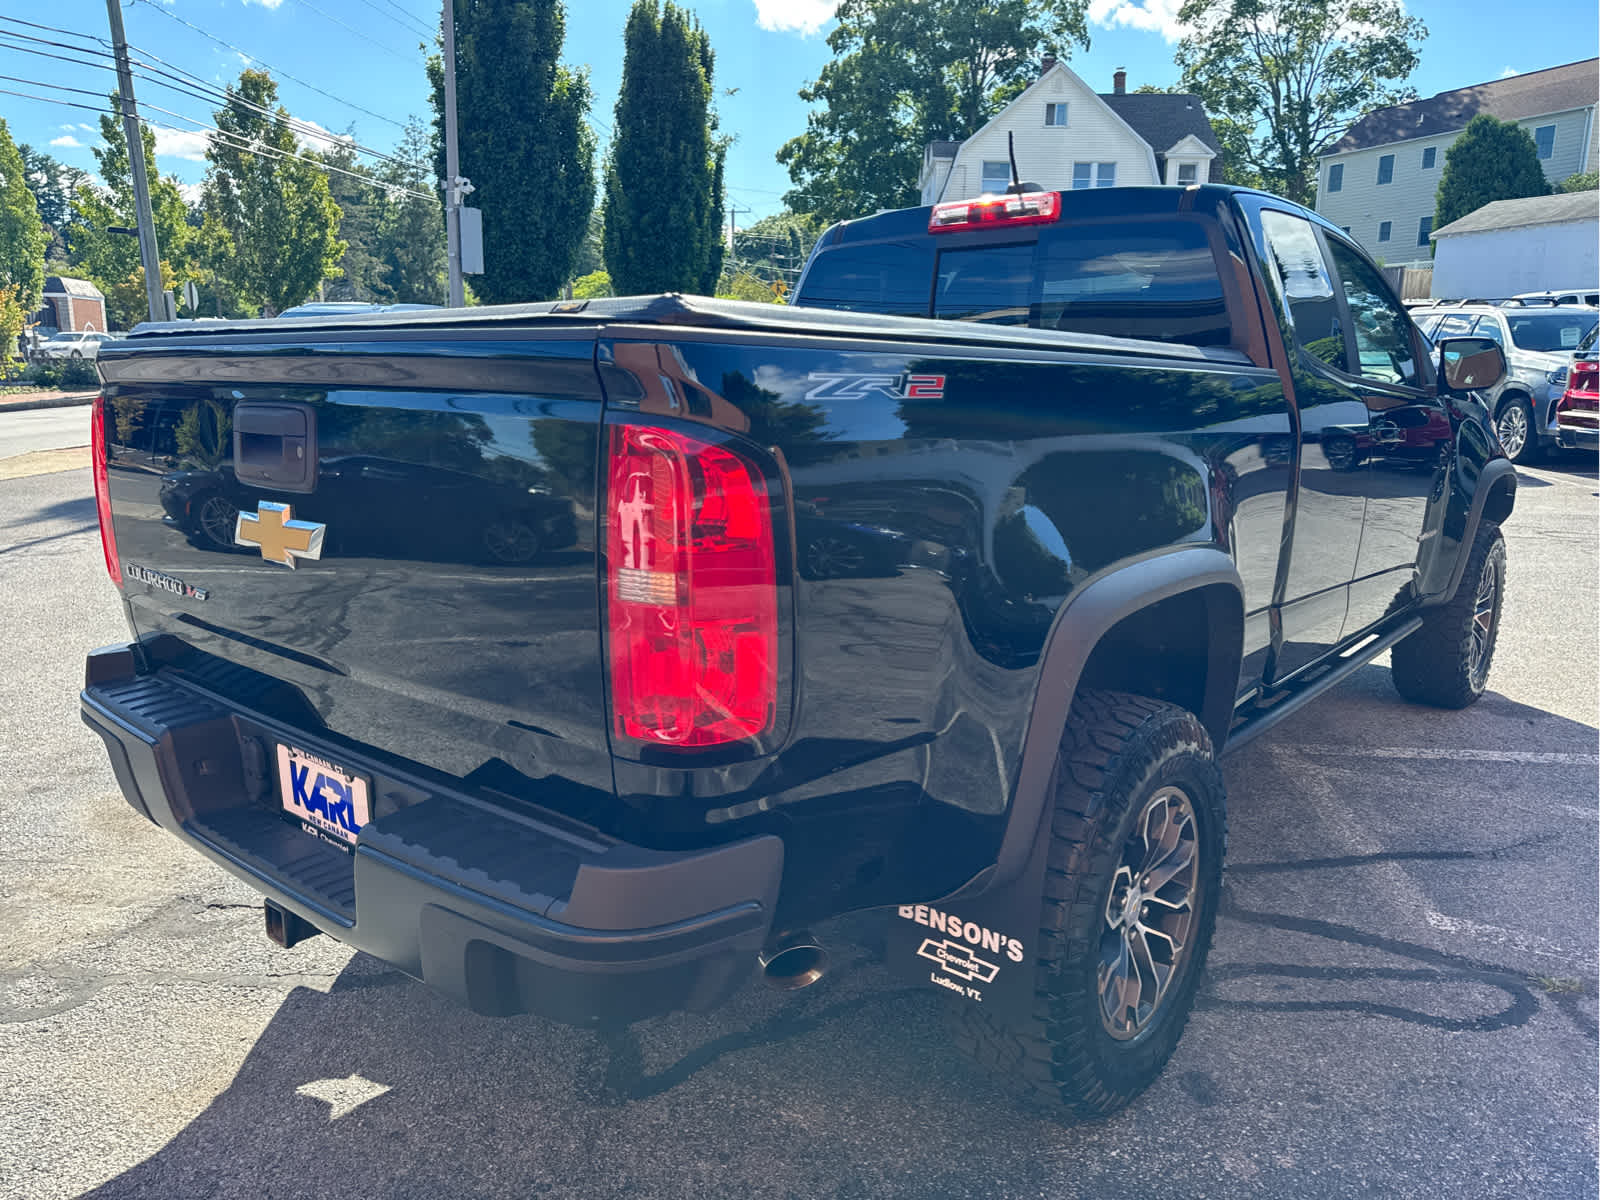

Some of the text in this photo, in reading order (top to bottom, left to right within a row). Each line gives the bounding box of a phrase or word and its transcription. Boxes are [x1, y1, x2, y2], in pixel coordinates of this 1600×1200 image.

[804, 371, 946, 400] ZR2
[289, 759, 362, 835] KARL
[898, 904, 1024, 962] BENSON'S
[936, 948, 980, 973] Chevrolet
